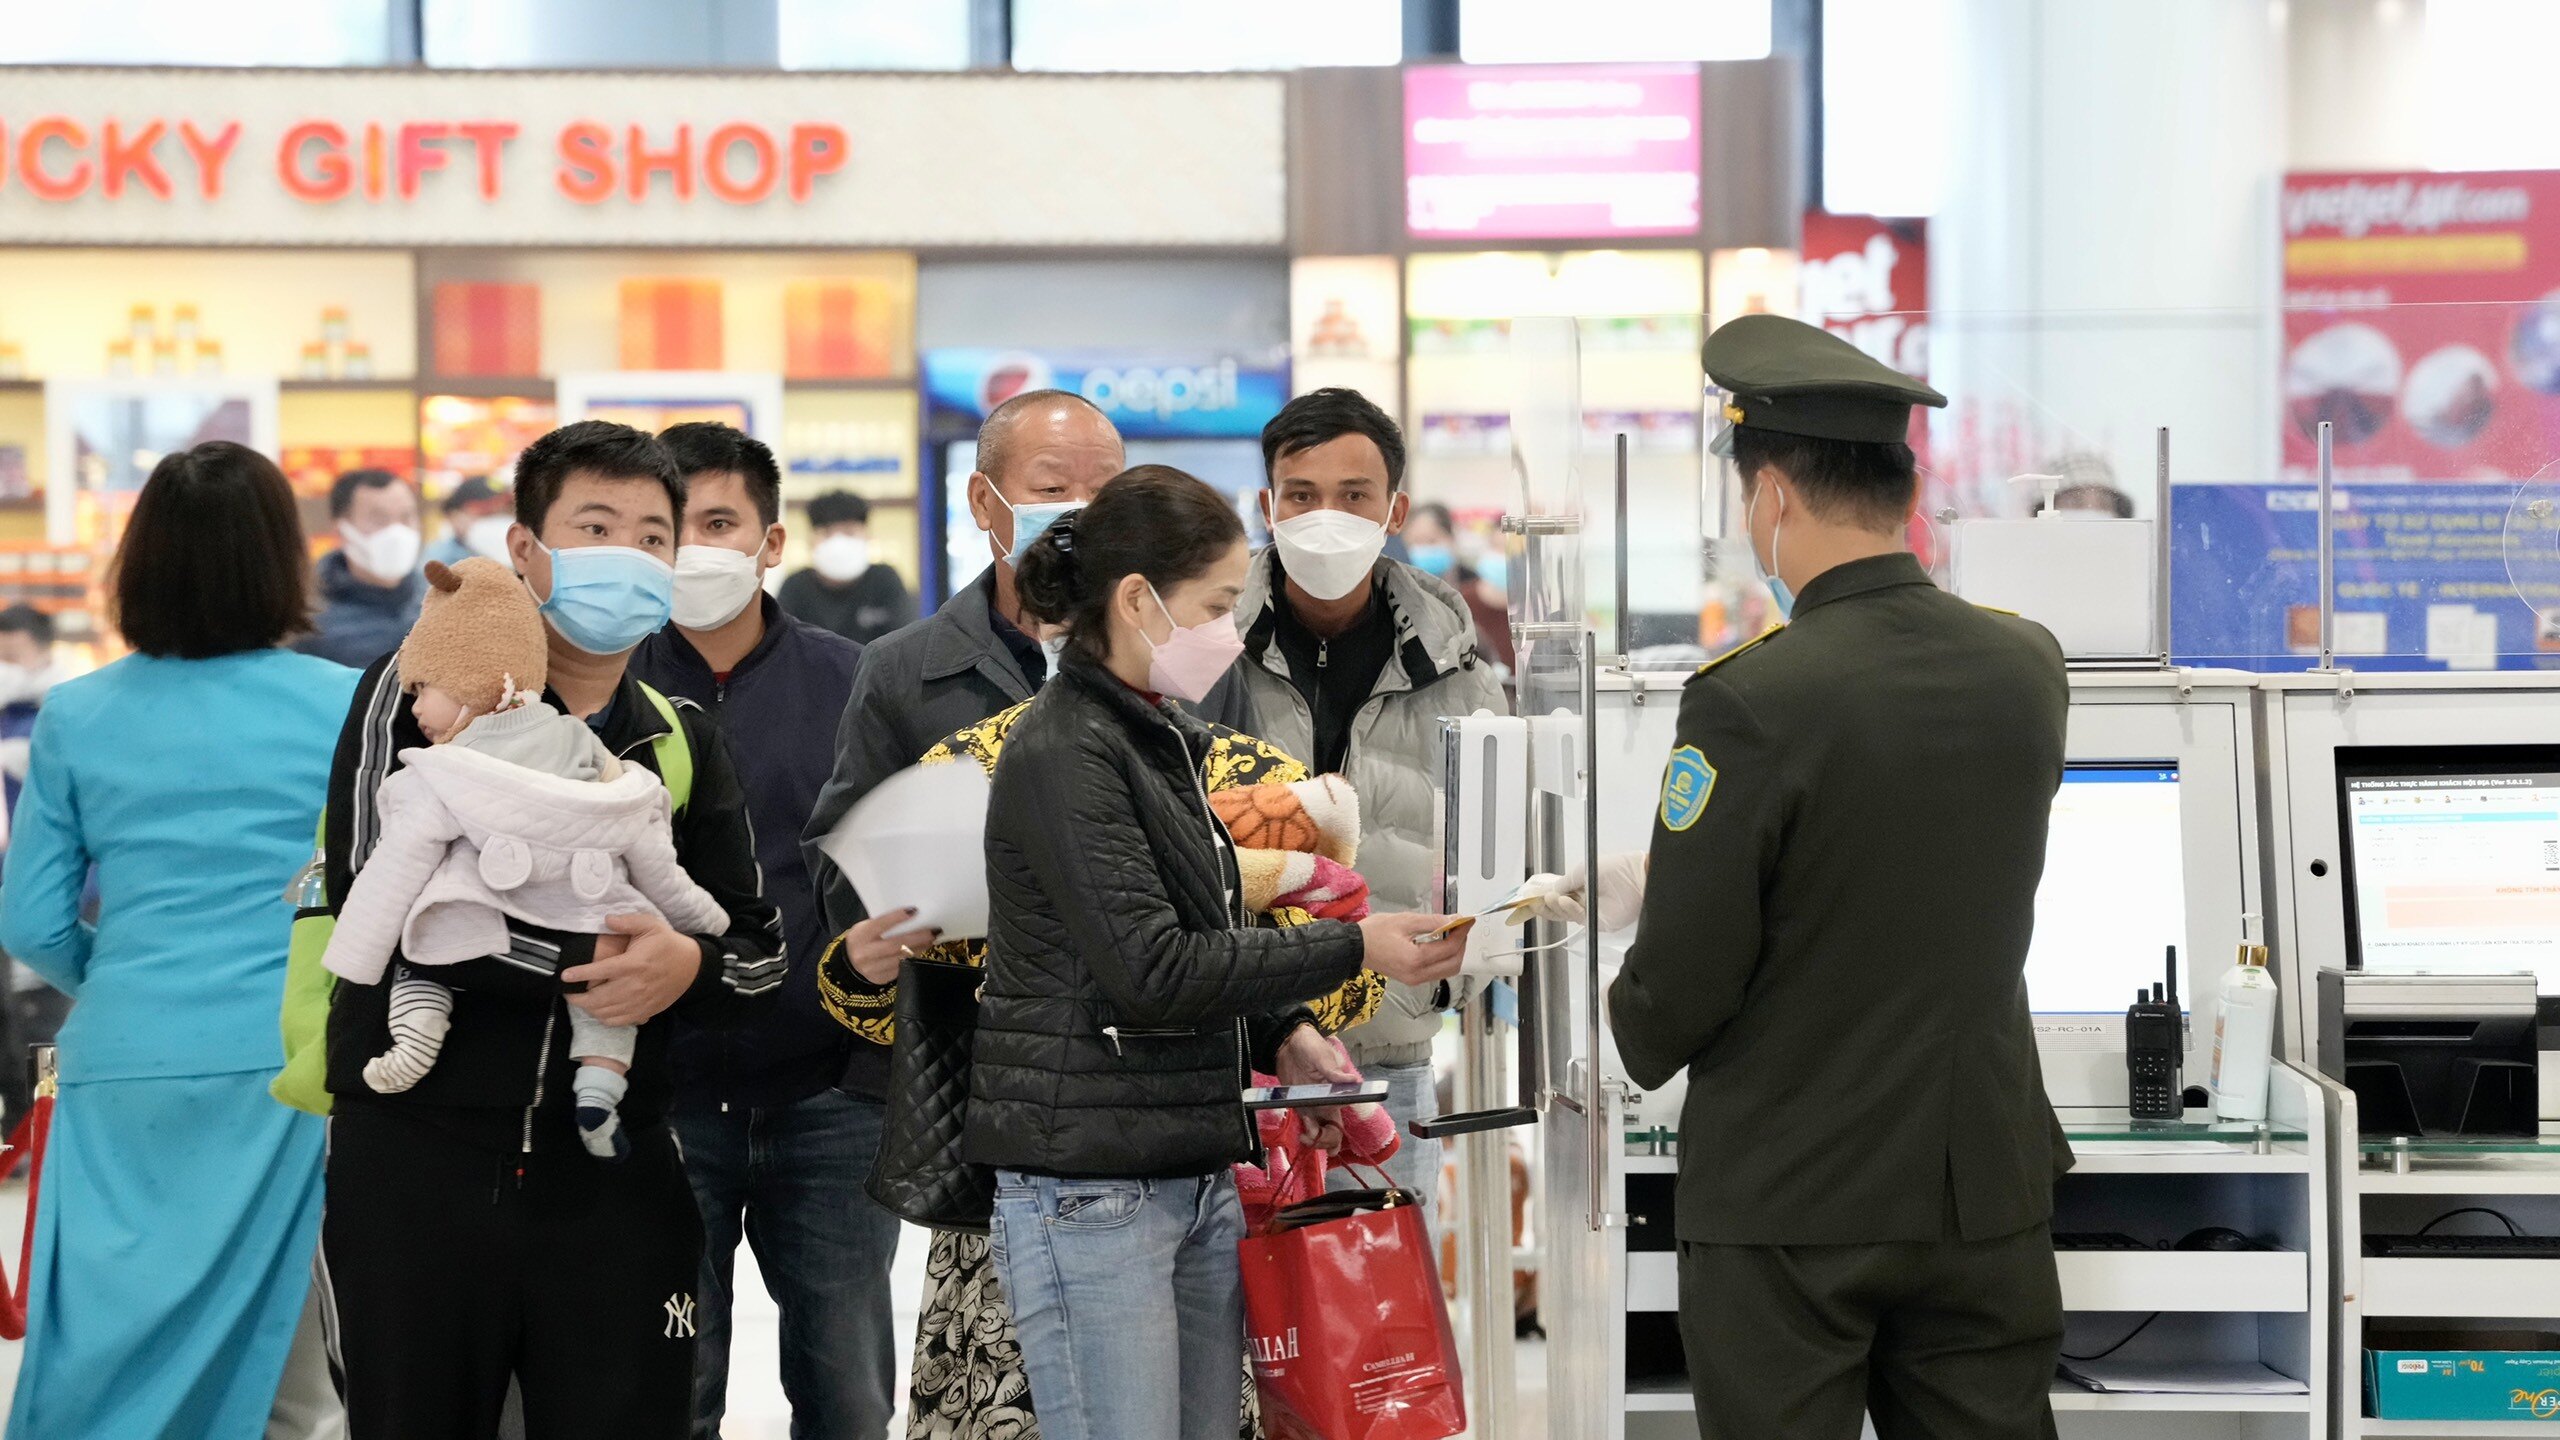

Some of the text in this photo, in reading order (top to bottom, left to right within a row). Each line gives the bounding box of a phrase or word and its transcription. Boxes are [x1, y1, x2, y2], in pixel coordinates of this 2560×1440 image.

[276, 120, 522, 204] GIFT
[554, 120, 850, 204] SHOP
[663, 1292, 697, 1339] NY
